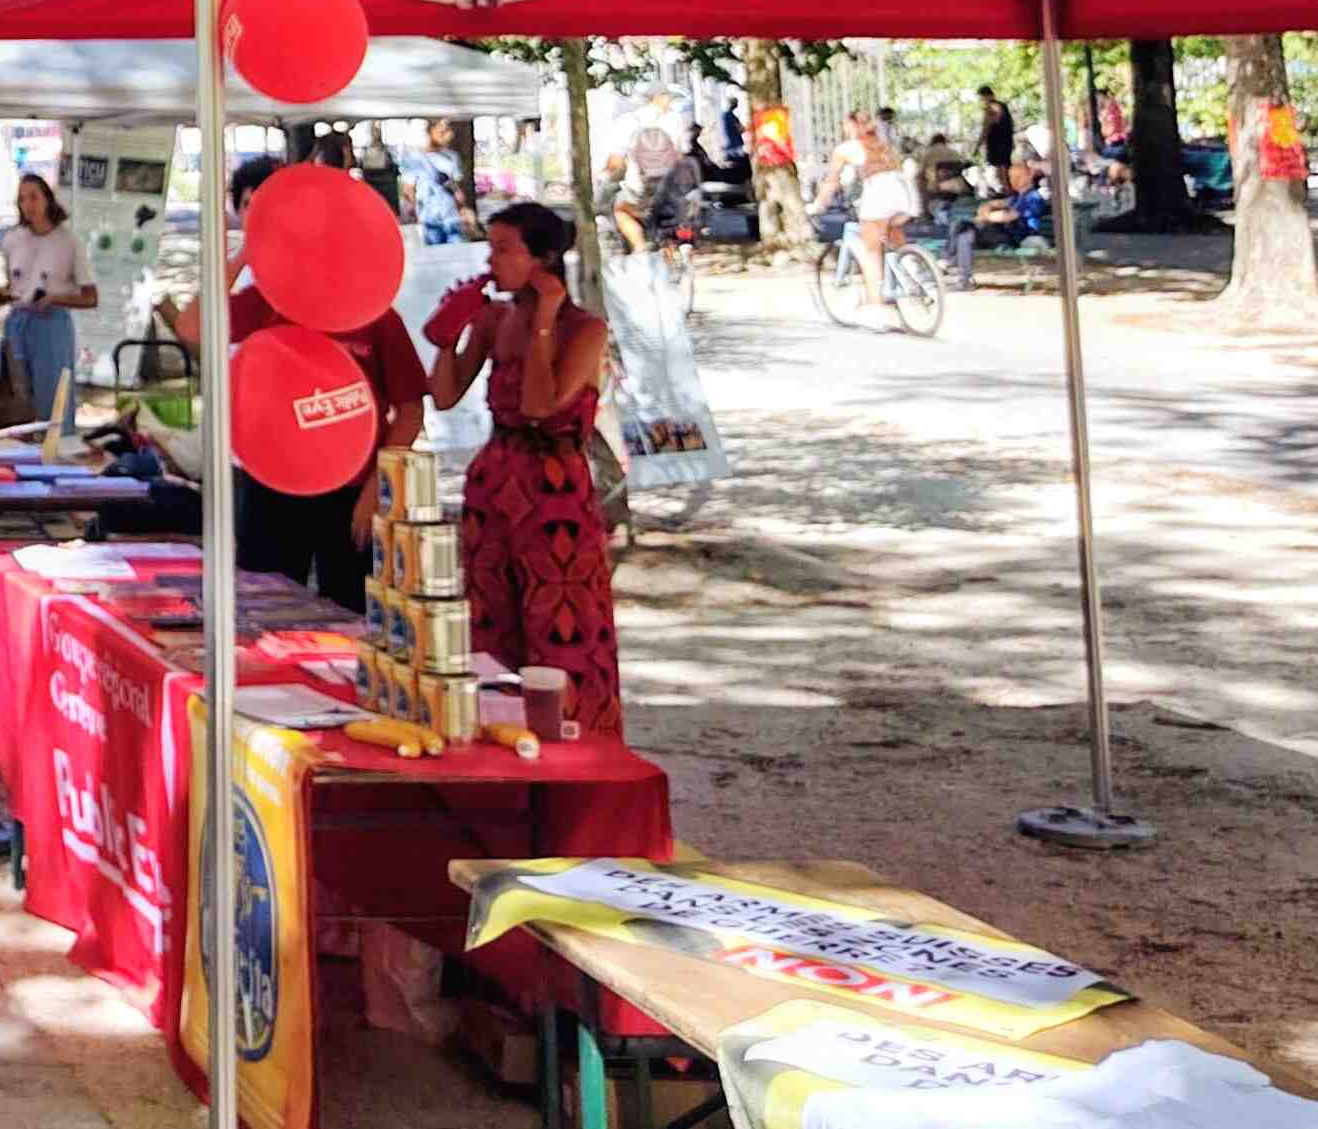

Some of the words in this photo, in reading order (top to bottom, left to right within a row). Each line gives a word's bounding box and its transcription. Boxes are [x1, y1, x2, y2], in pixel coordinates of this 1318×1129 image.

[616, 884, 742, 916] DANS
[701, 893, 862, 932] ARMES
[870, 929, 1078, 979] SUISSES
[723, 946, 948, 1007] NON
